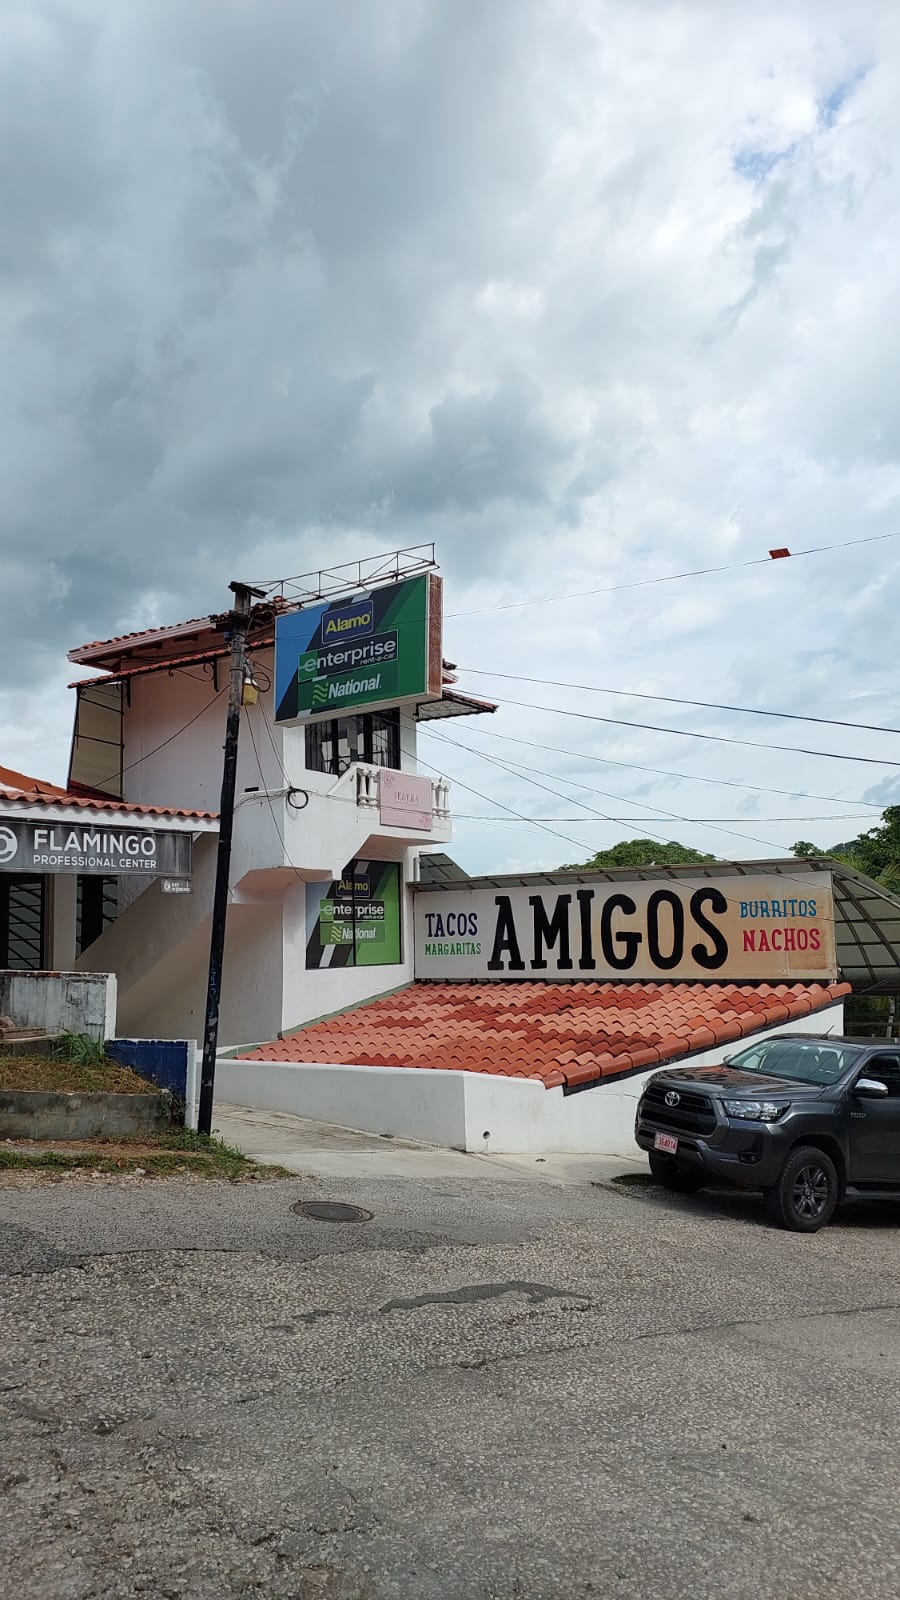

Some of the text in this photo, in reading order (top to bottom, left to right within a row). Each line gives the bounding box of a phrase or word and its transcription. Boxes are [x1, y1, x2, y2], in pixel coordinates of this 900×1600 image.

[326, 613, 371, 635] Alamo
[303, 640, 396, 673] enterprise
[328, 673, 380, 699] National
[33, 829, 156, 856] FLAMINGO
[33, 854, 157, 869] PROFESSIONAL CENTER
[740, 899, 817, 918] BURRITOS
[425, 912, 478, 937] TACOS
[487, 887, 728, 970] AMIGOS
[425, 942, 482, 956] MARGARITAS
[743, 928, 821, 952] NACHOS
